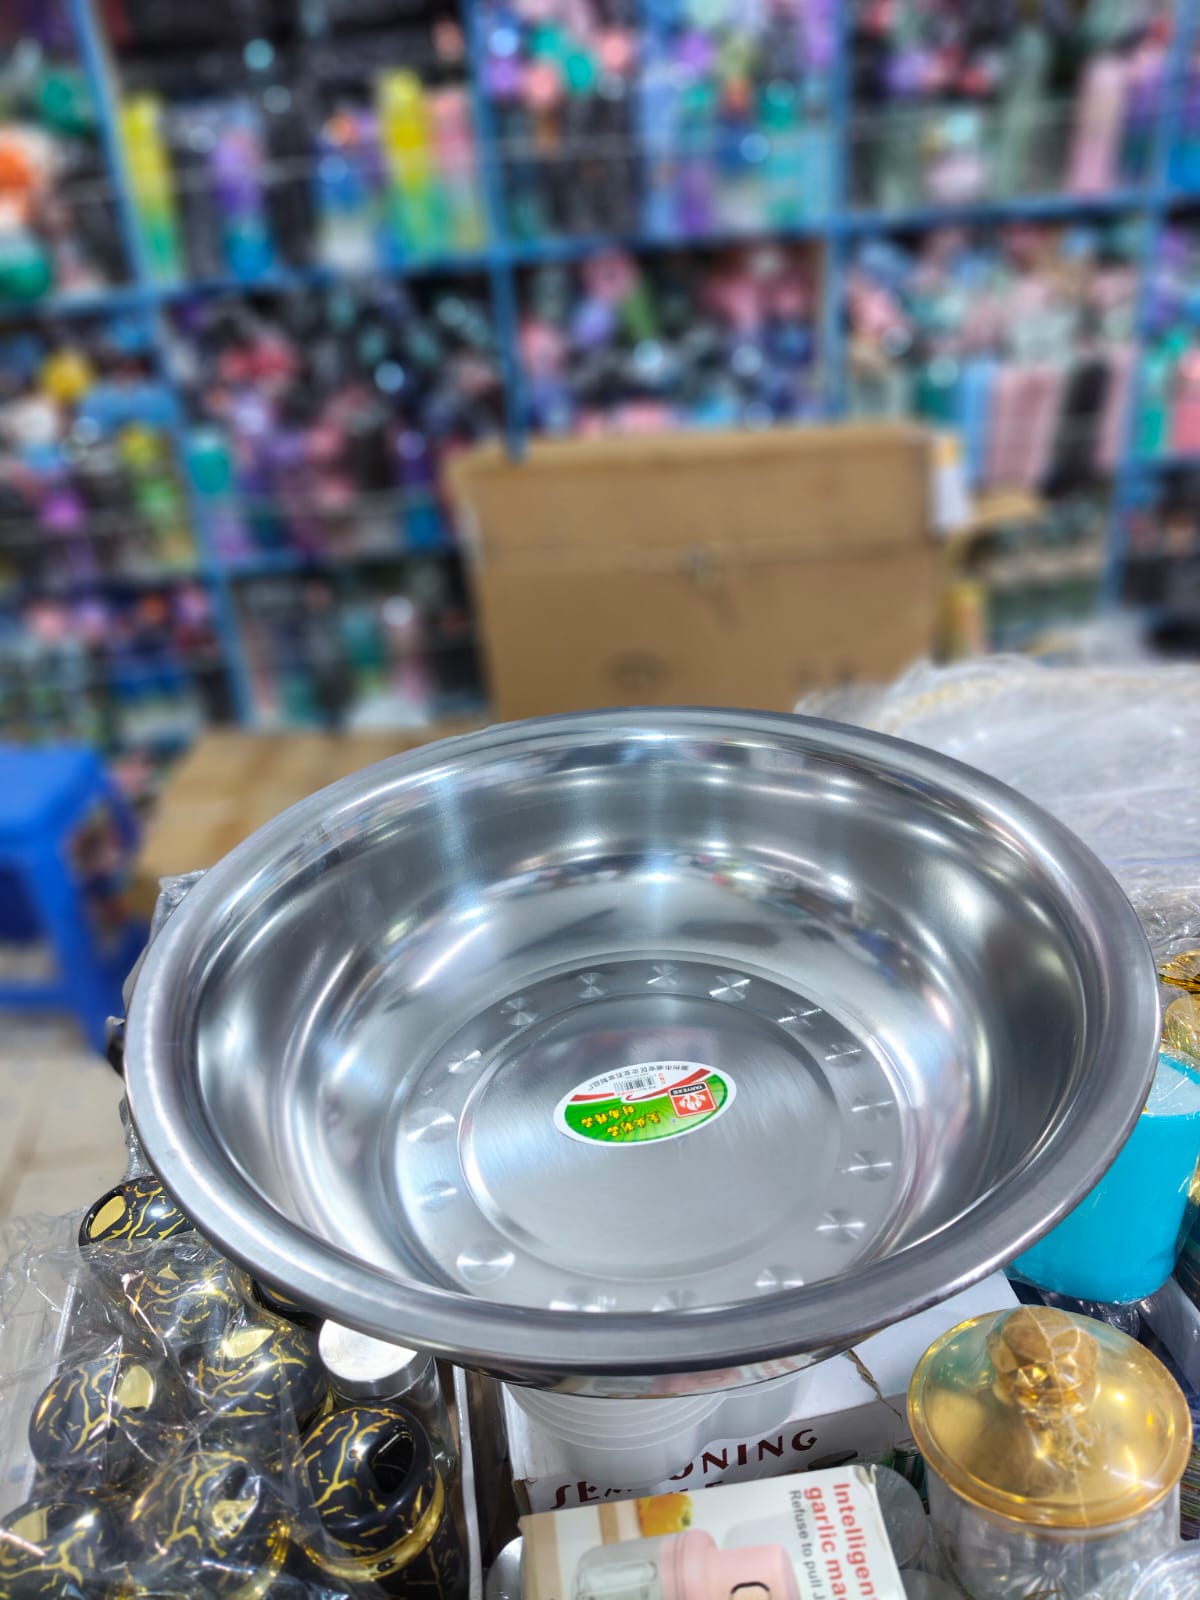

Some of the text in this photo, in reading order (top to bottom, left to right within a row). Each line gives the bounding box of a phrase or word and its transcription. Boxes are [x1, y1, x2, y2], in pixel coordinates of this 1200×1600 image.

[550, 1428, 818, 1510] SENING
[789, 1489, 809, 1540] Refuse
[804, 1486, 849, 1600] garlic ma
[833, 1483, 880, 1600] Intelligen
[801, 1542, 814, 1558] to
[803, 1560, 823, 1588] pull
